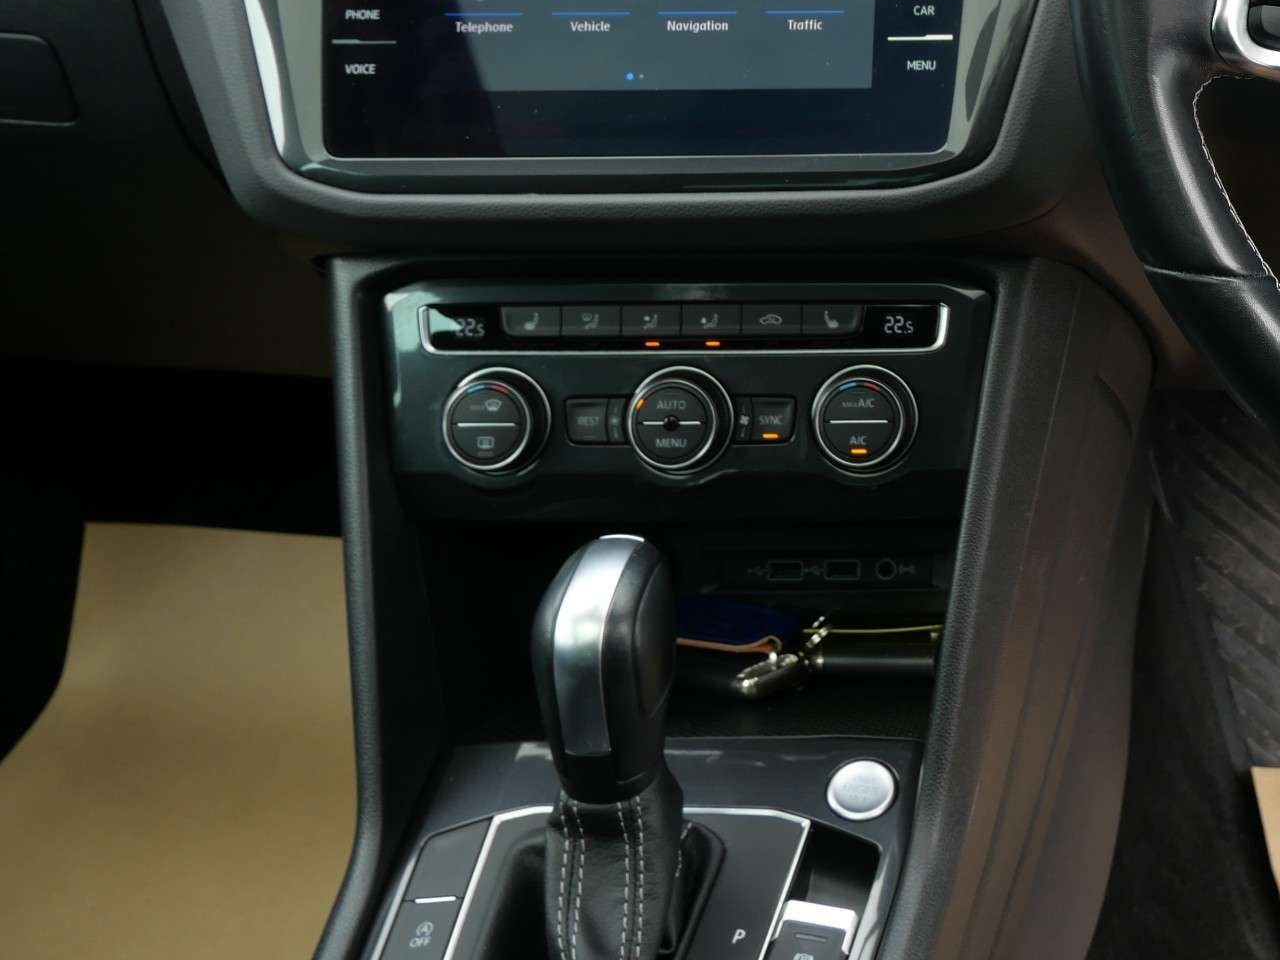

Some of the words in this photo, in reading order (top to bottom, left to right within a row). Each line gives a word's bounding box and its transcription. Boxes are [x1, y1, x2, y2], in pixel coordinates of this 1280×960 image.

[345, 8, 380, 20] PHONE
[912, 4, 935, 16] CAR
[455, 21, 513, 36] Telephone
[570, 19, 611, 32] Vehicle
[666, 18, 729, 35] Navigation
[787, 18, 823, 32] Traffic
[344, 63, 376, 75] VOICE
[906, 60, 936, 72] MENU
[656, 400, 687, 411] AUTO
[576, 416, 600, 426] REST
[759, 415, 783, 425] SYNC
[655, 437, 687, 448] MENU
[850, 435, 867, 446] A/C
[409, 935, 431, 948] OFF
[732, 928, 746, 944] P
